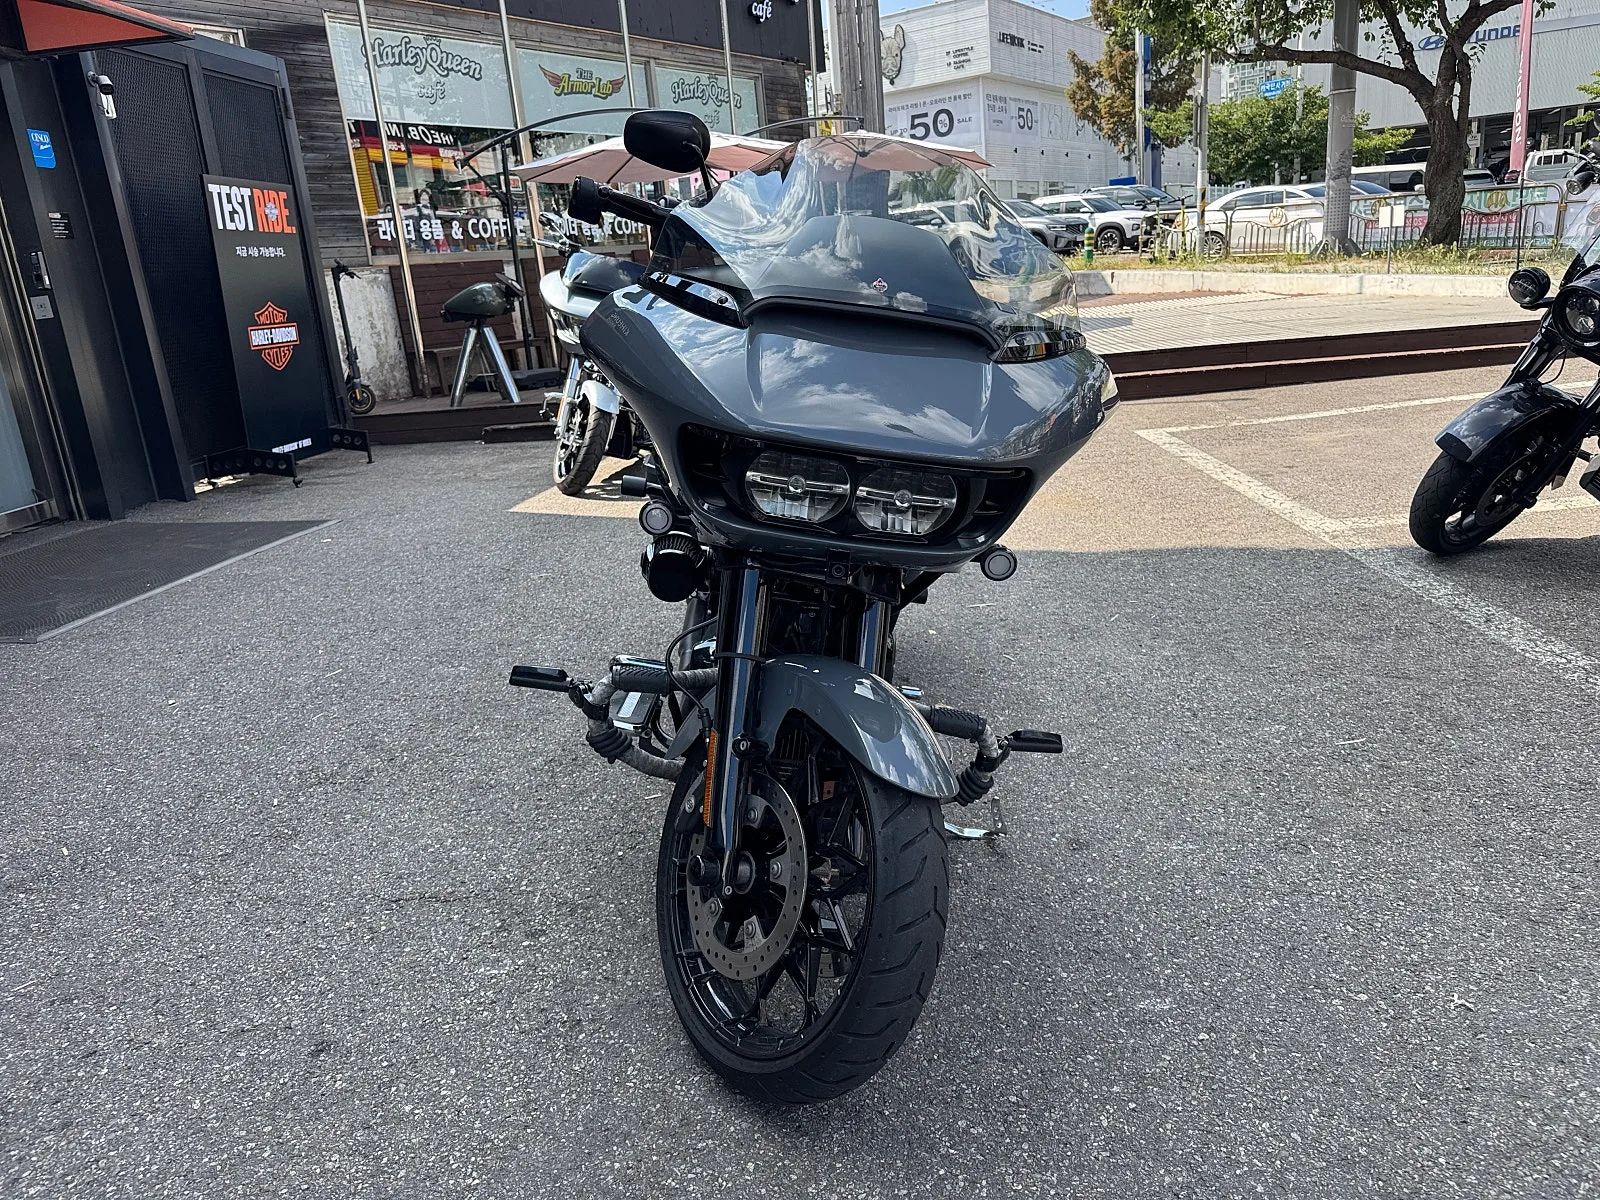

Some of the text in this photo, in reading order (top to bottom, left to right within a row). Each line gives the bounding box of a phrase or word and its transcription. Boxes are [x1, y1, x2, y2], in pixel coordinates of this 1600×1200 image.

[751, 0, 772, 22] café
[576, 68, 593, 79] THE
[418, 79, 446, 104] café
[207, 184, 254, 231] TEST
[420, 219, 444, 240] 용품
[451, 220, 464, 239] &
[467, 217, 526, 239] COFFE
[235, 246, 247, 257] 지금
[259, 306, 284, 324] MOTOR
[250, 326, 297, 346] HARLEY-DAVIDSON
[264, 347, 289, 367] CYCLES
